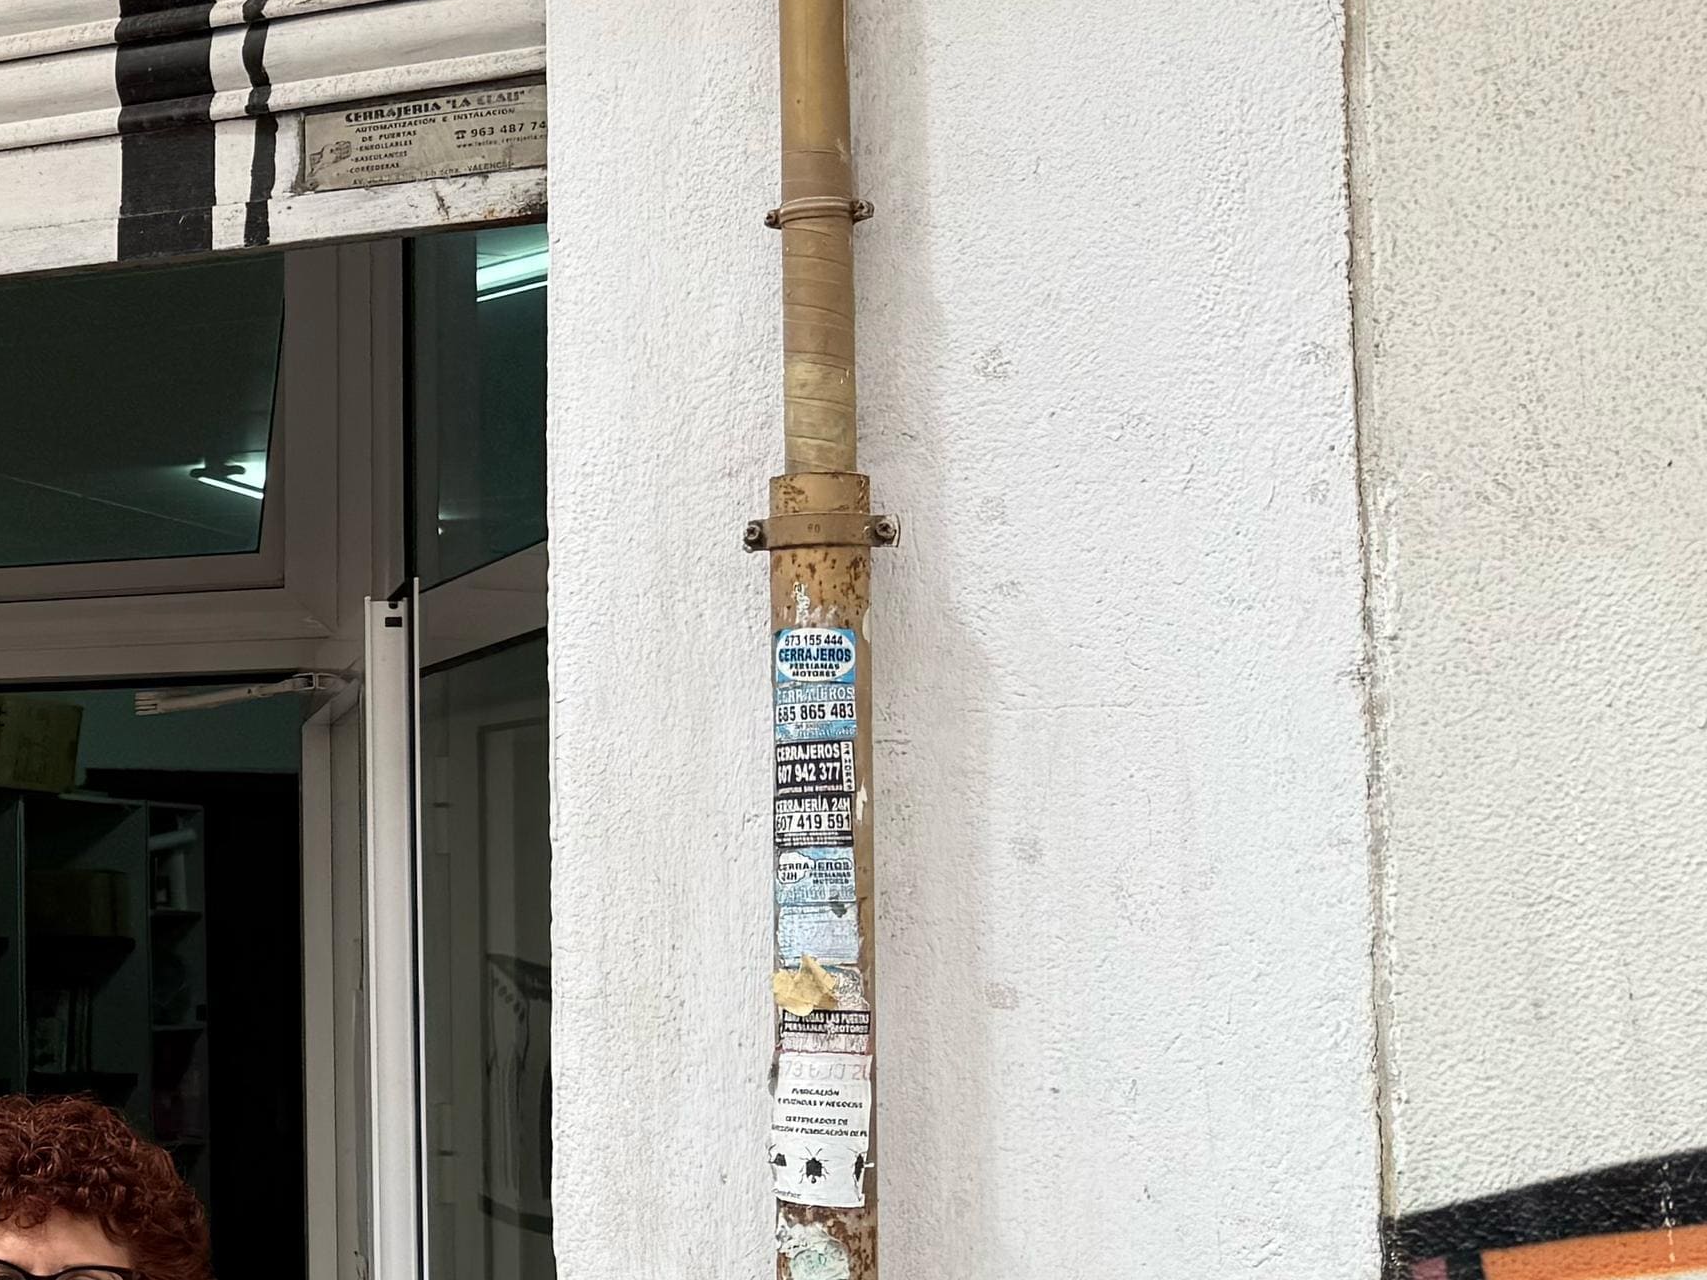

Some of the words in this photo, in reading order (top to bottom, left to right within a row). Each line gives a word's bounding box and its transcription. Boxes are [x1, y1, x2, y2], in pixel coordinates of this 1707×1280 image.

[470, 127, 495, 138] 963
[499, 123, 525, 135] 487
[803, 634, 822, 646] 155
[824, 634, 843, 646] 444
[778, 648, 851, 663] CERRAJEROS
[800, 704, 826, 721] 865
[830, 702, 854, 719] 483
[777, 743, 841, 762] CERRAJEROS
[794, 763, 817, 783] 942
[818, 761, 841, 782] 377
[796, 814, 823, 830] 419
[827, 813, 851, 830] 591
